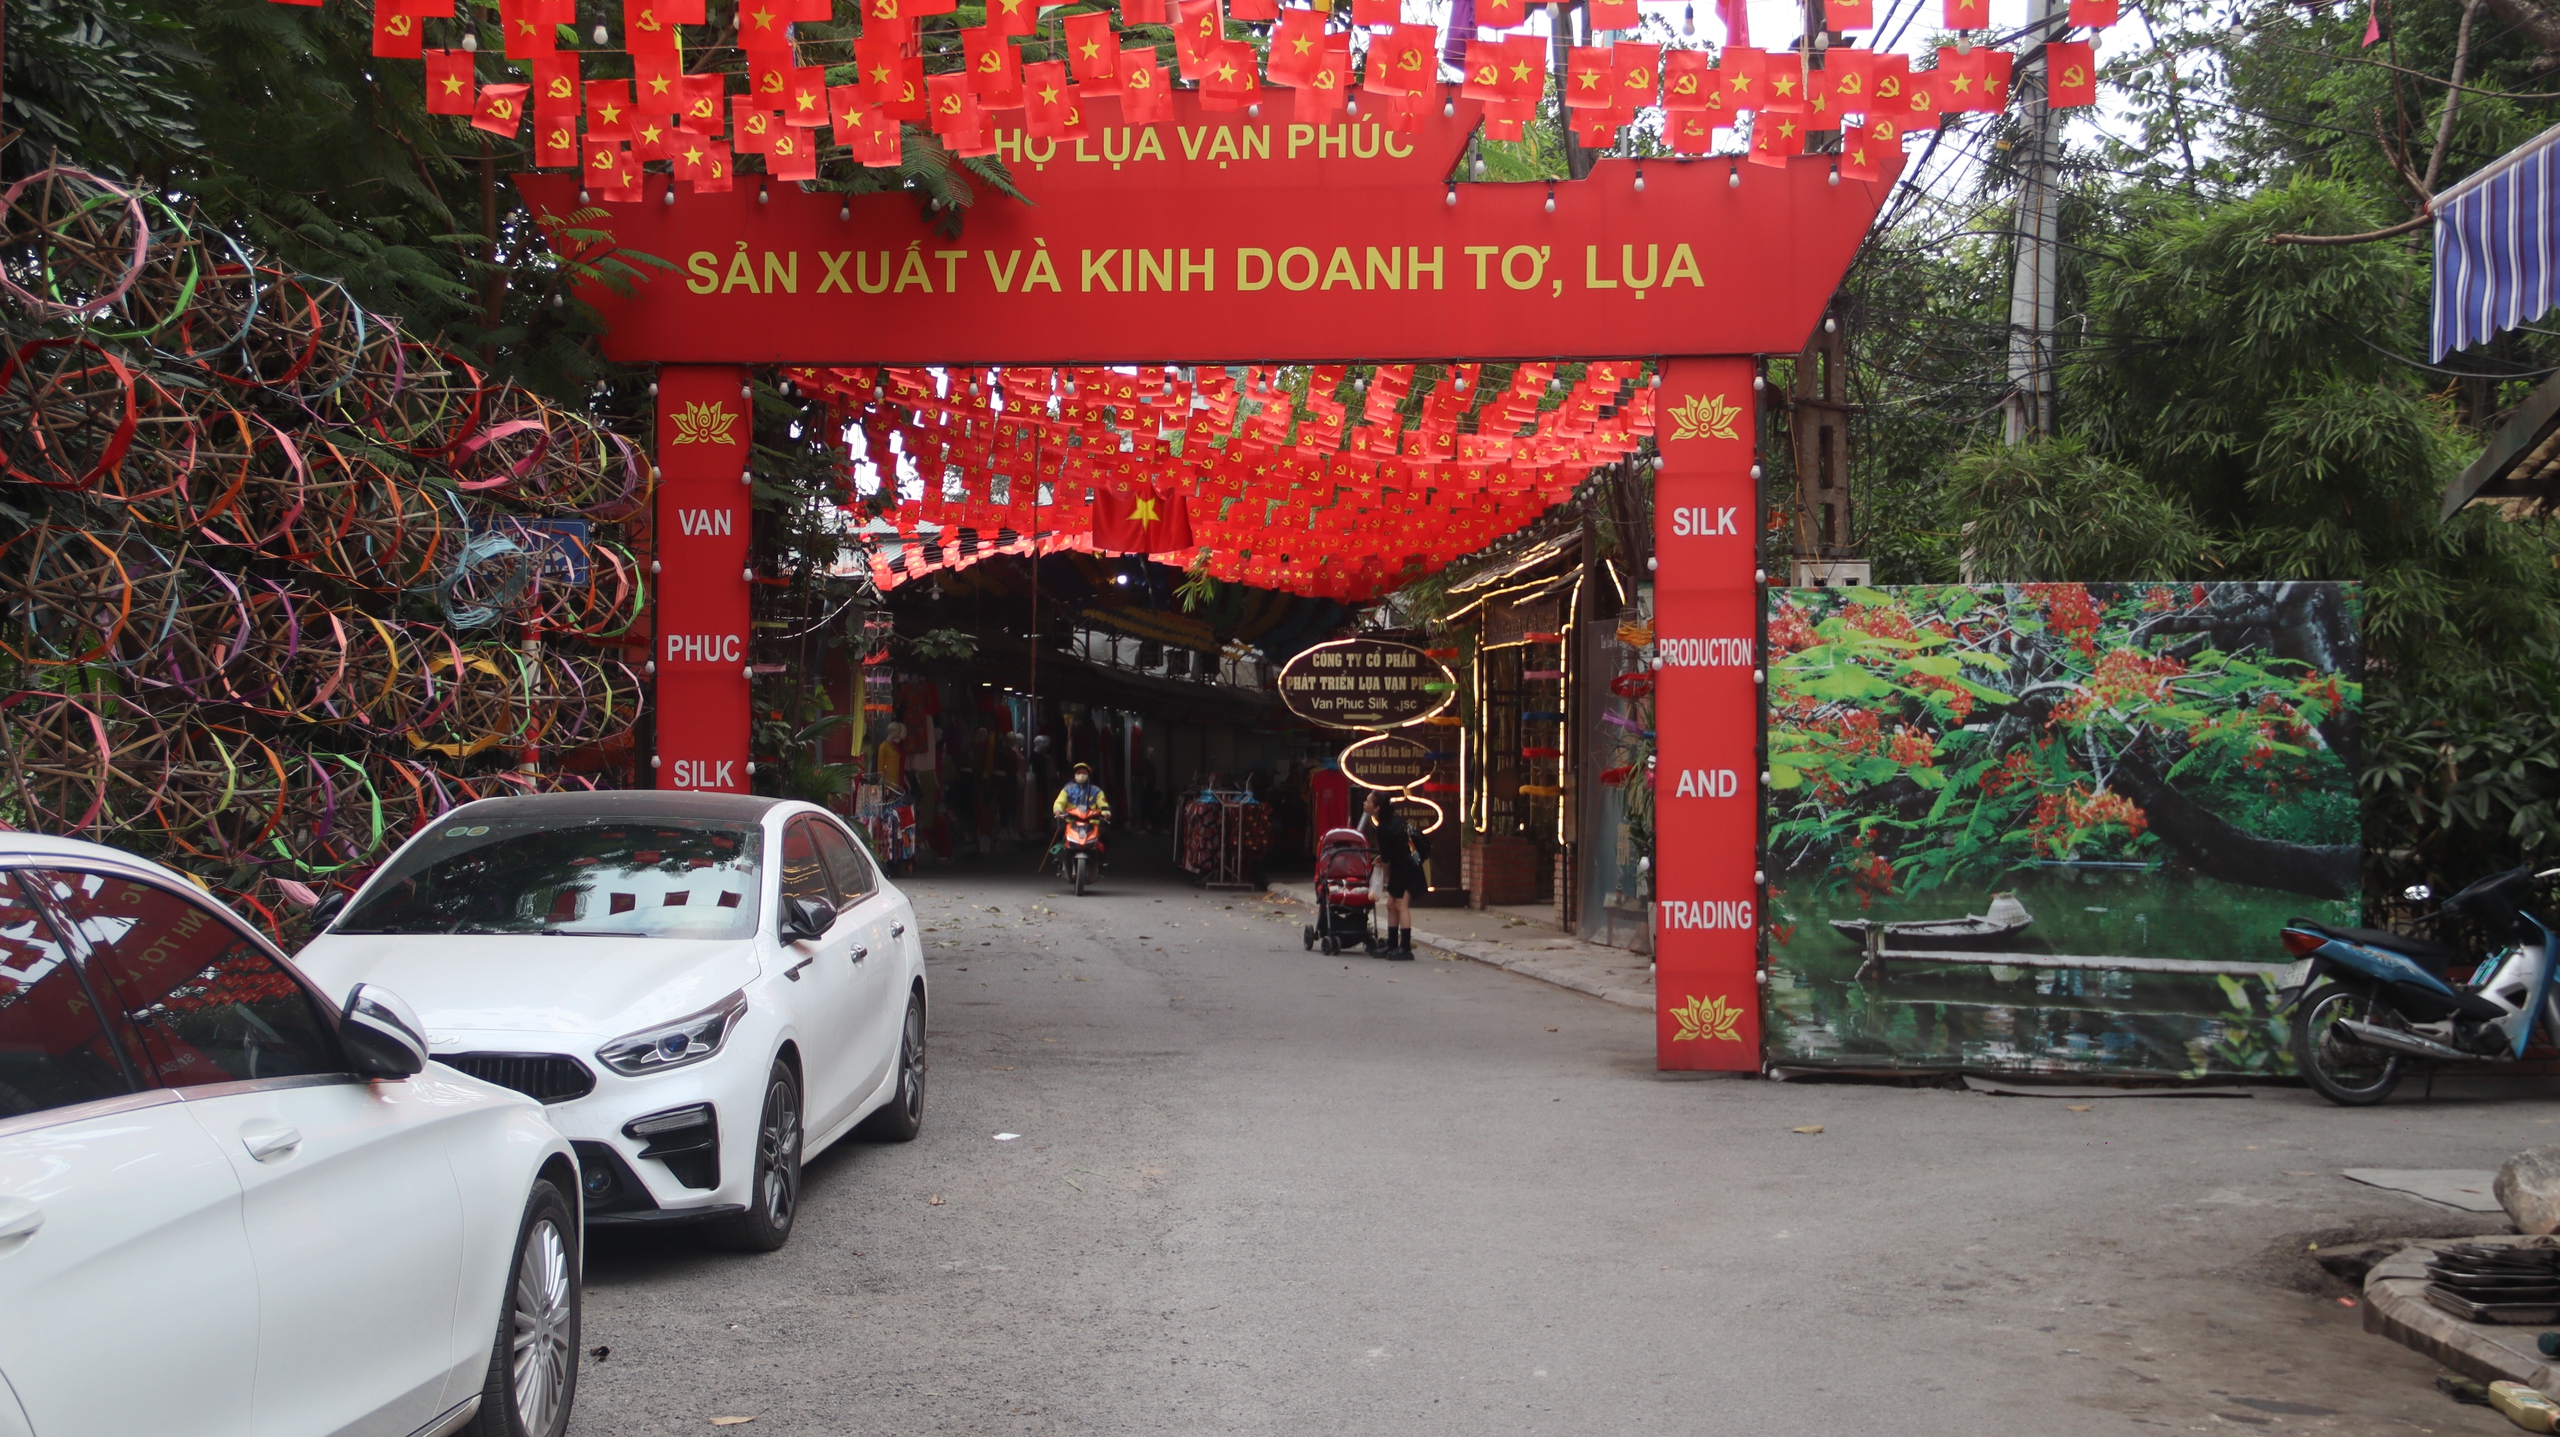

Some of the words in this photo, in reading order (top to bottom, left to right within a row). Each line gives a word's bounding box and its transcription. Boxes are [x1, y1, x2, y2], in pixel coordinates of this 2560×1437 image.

[1075, 125, 1166, 171] LỤA
[1176, 124, 1270, 169] VẠN
[1287, 113, 1414, 159] PHÚC
[686, 240, 798, 295] SẢN
[816, 239, 968, 294] XUẤT
[985, 237, 1062, 293] VÀ
[1081, 248, 1214, 293] KINH
[1237, 246, 1444, 291] DOANH
[1464, 245, 1563, 298] TƠ,
[1586, 243, 1705, 300] LỤA
[678, 508, 731, 536] VAN
[1672, 507, 1738, 537] SILK
[667, 634, 740, 662] PHUC
[1312, 650, 1342, 667] CÔNG
[1346, 653, 1362, 668] TY
[1366, 646, 1381, 668] CỔ
[1385, 649, 1416, 668] PHẦN
[1659, 637, 1752, 667] PRODUCTION
[1286, 673, 1316, 690] PHÁT
[1319, 670, 1354, 690] TRIỂN
[1358, 676, 1380, 693] LỤA
[1383, 676, 1407, 693] VẠN
[1311, 697, 1333, 709] Van
[1336, 697, 1364, 709] Phuc
[1368, 696, 1388, 709] Silk
[673, 759, 735, 788] SILK
[1675, 769, 1738, 798] AND
[1660, 900, 1752, 930] TRADING
